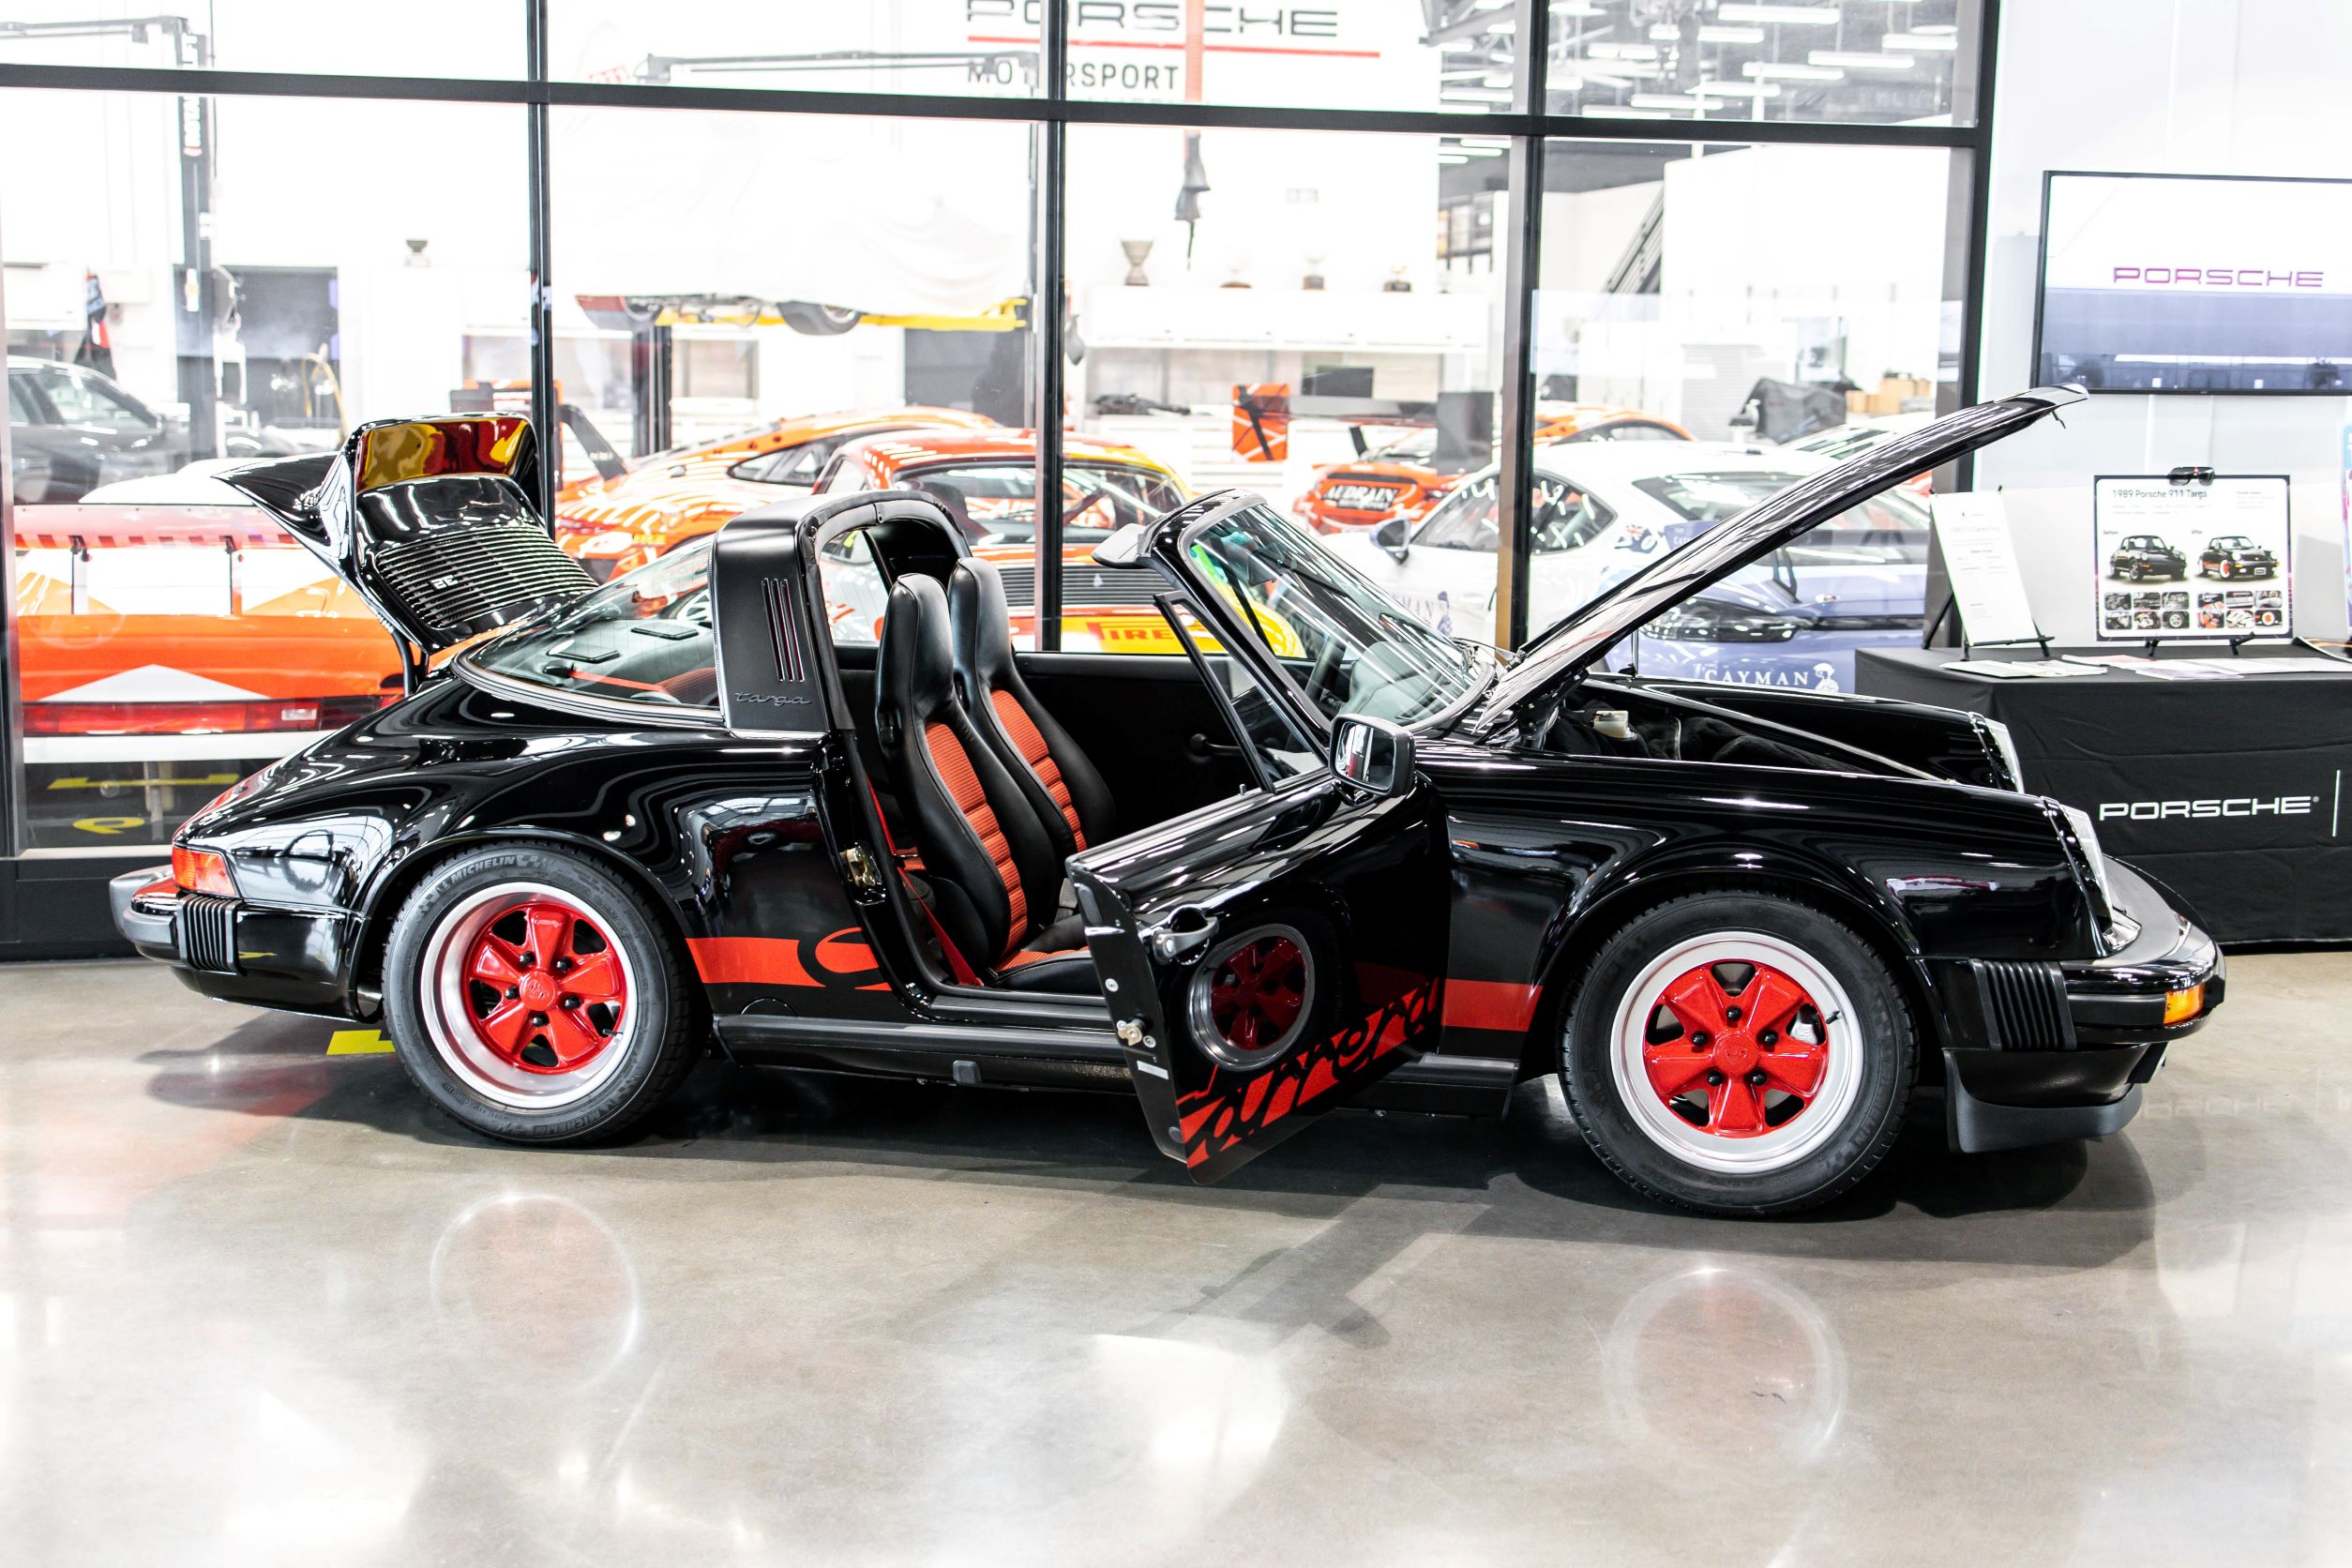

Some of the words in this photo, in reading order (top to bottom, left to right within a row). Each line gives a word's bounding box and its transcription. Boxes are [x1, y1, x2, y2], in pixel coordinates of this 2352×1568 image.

[2113, 267, 2324, 288] PORSCHE
[2112, 489, 2133, 499] 1989
[2135, 489, 2166, 499] Porsche
[2168, 489, 2184, 499] 911
[2185, 489, 2208, 501] Targa
[1704, 667, 1809, 686] CAYMAN
[734, 692, 811, 707] targa
[2099, 795, 2312, 822] PORSCHE
[450, 854, 515, 884] MICHELIN
